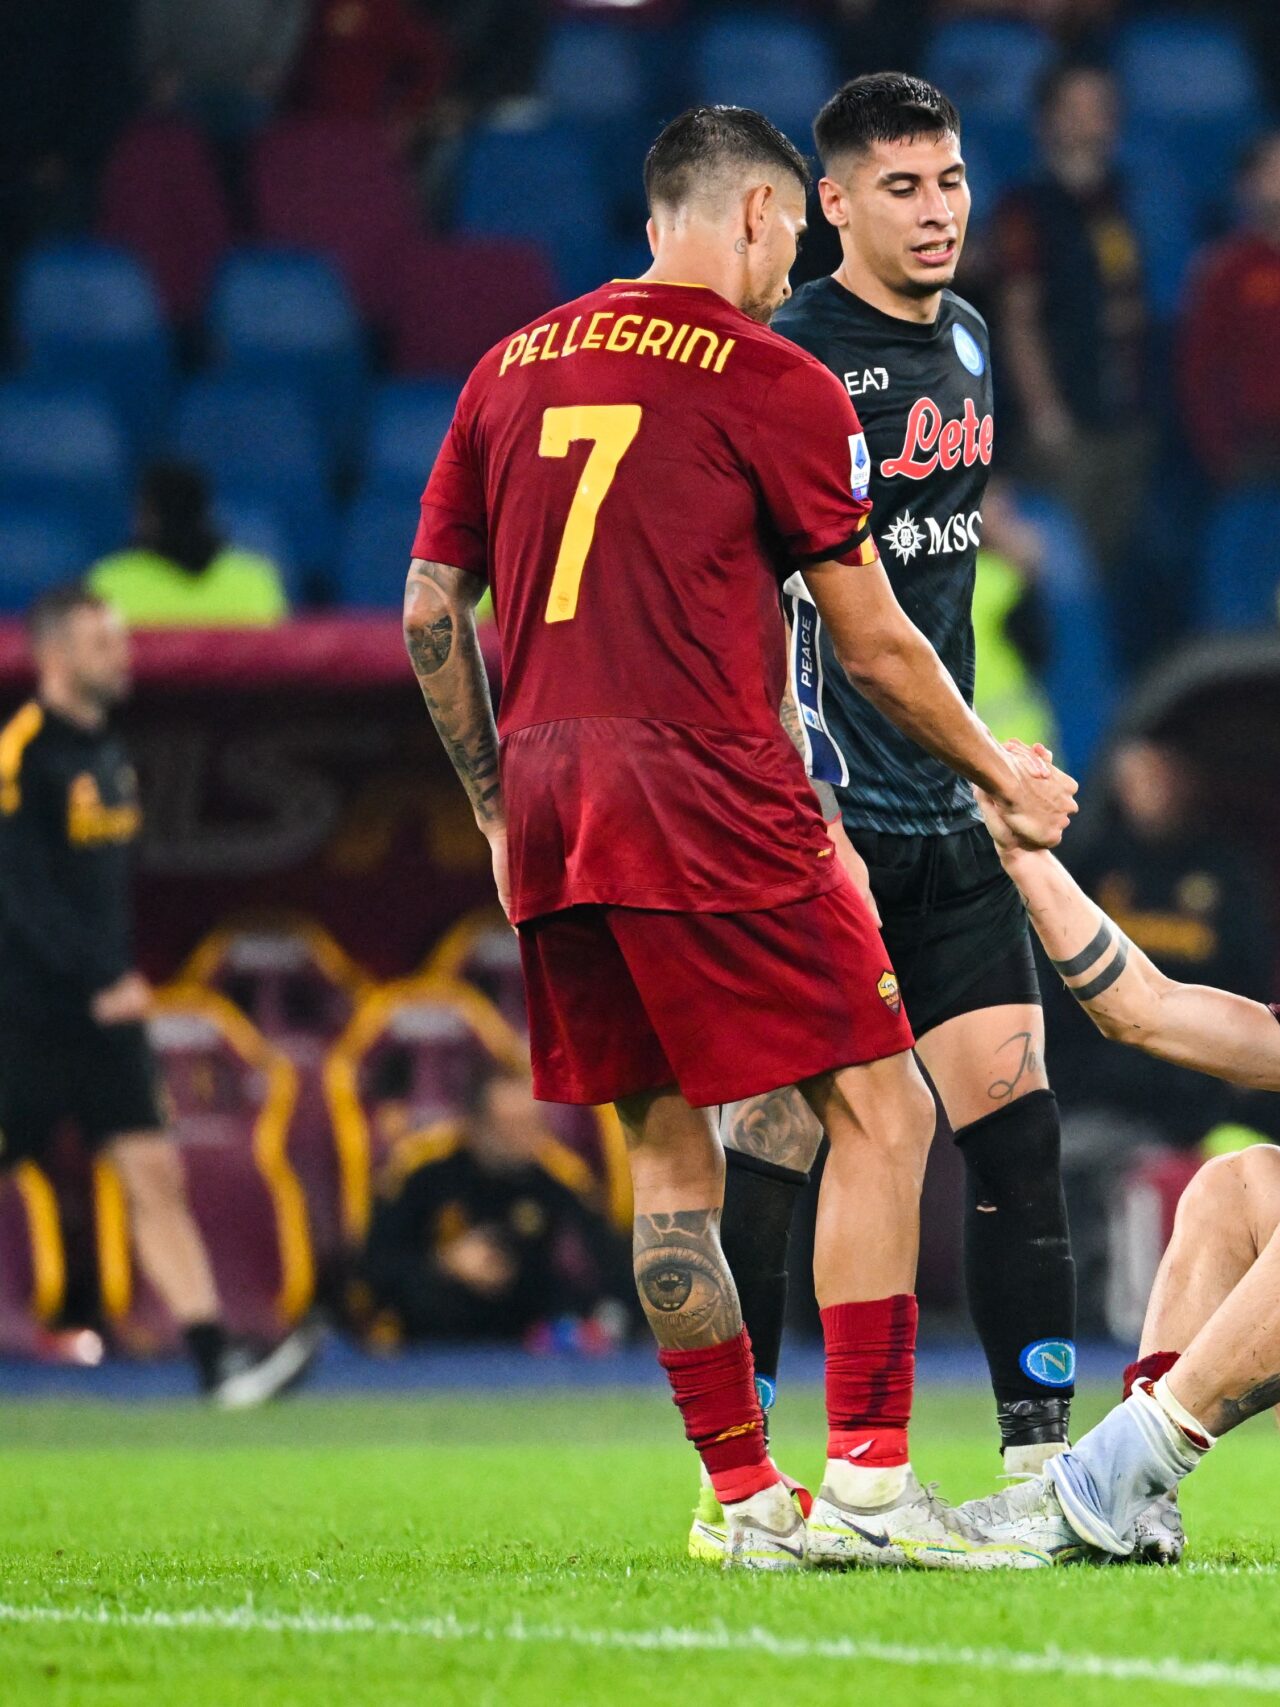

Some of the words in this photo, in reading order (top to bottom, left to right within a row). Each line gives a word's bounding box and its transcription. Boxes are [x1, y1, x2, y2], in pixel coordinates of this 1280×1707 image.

[498, 312, 736, 377] PELLEGRINI
[880, 396, 994, 480] Lete
[538, 404, 643, 624] 7
[924, 510, 983, 555] MSC
[800, 615, 813, 688] PEACE
